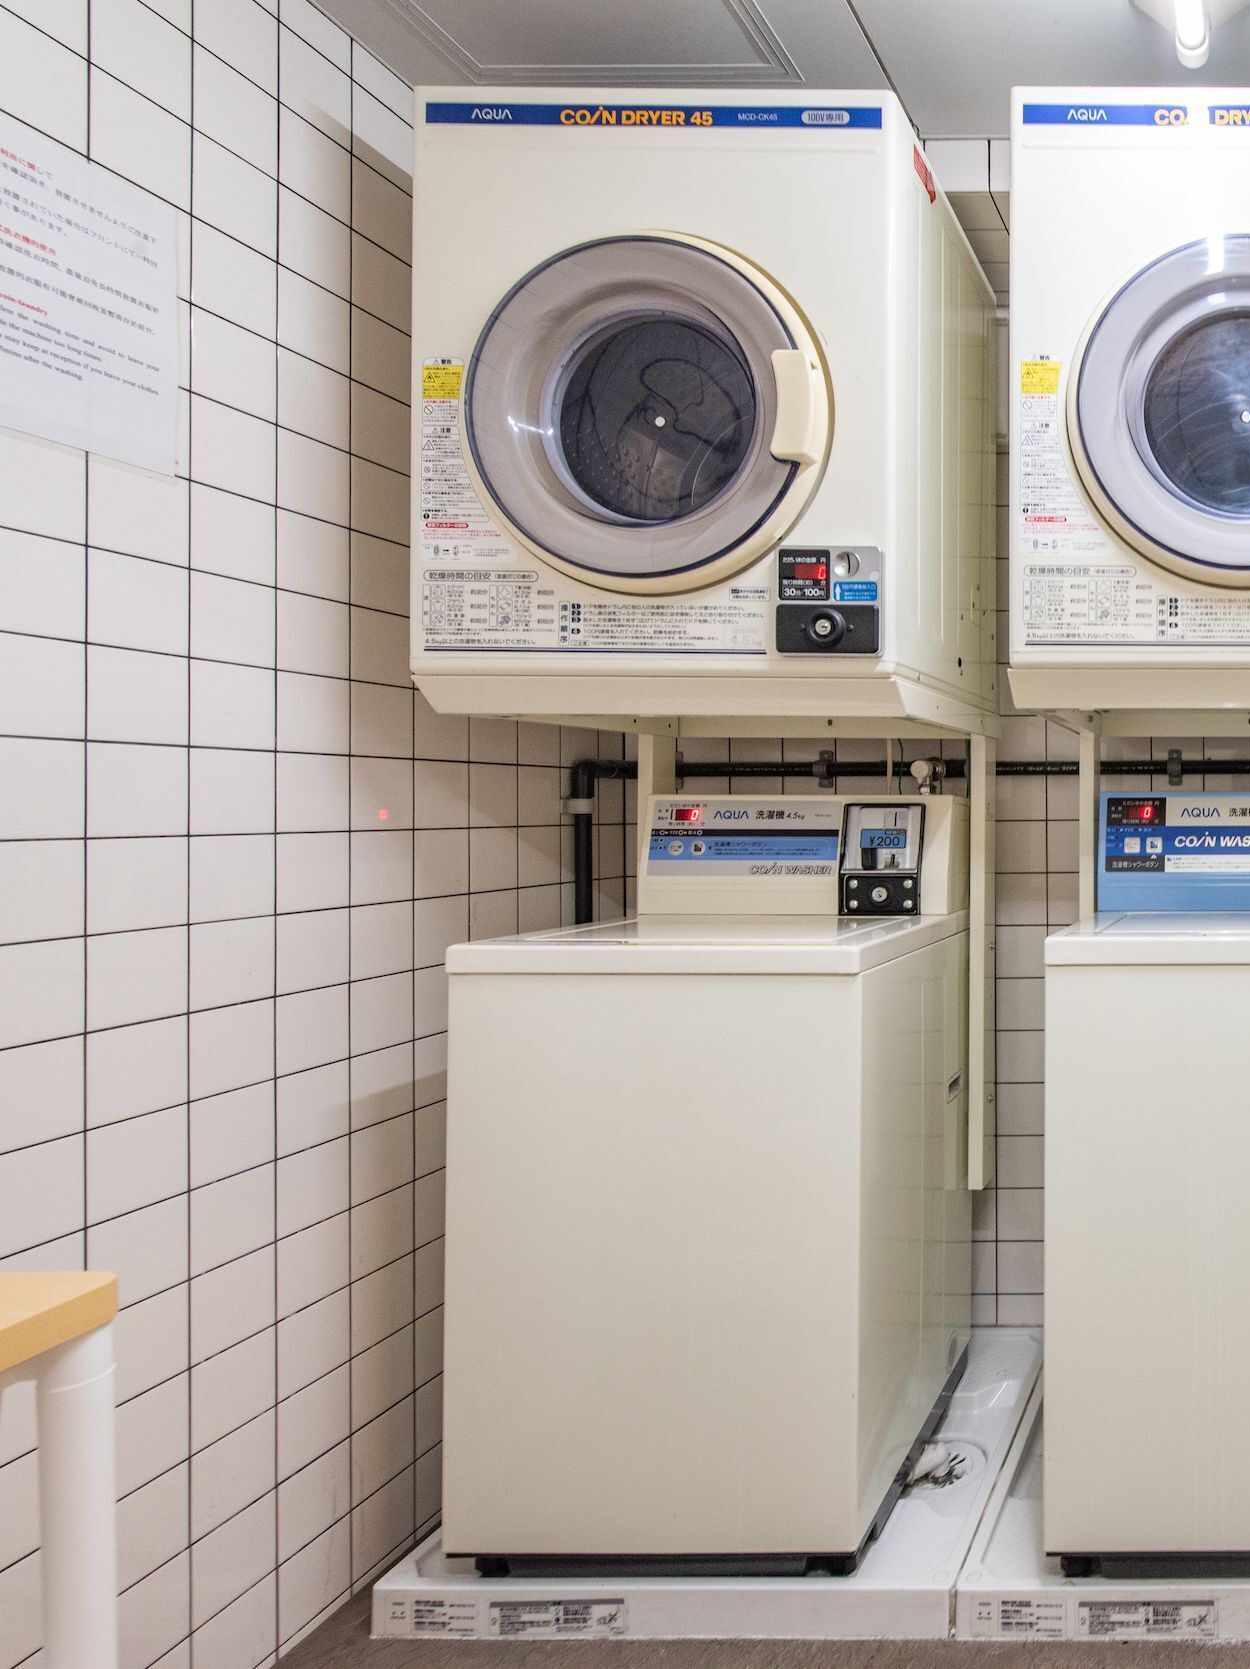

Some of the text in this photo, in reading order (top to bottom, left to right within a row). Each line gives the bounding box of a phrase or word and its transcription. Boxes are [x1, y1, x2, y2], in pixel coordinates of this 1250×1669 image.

[471, 108, 513, 120] AQUA
[621, 109, 685, 126] DRYER
[690, 110, 713, 126] 45
[1067, 108, 1107, 121] AQUA
[690, 809, 699, 821] 0
[713, 810, 749, 820] AQUA
[755, 809, 785, 820] 洗濯機
[1143, 807, 1152, 819] 0
[1180, 807, 1221, 818] AQUA
[869, 835, 900, 847] ¥200
[785, 864, 832, 875] WASHER
